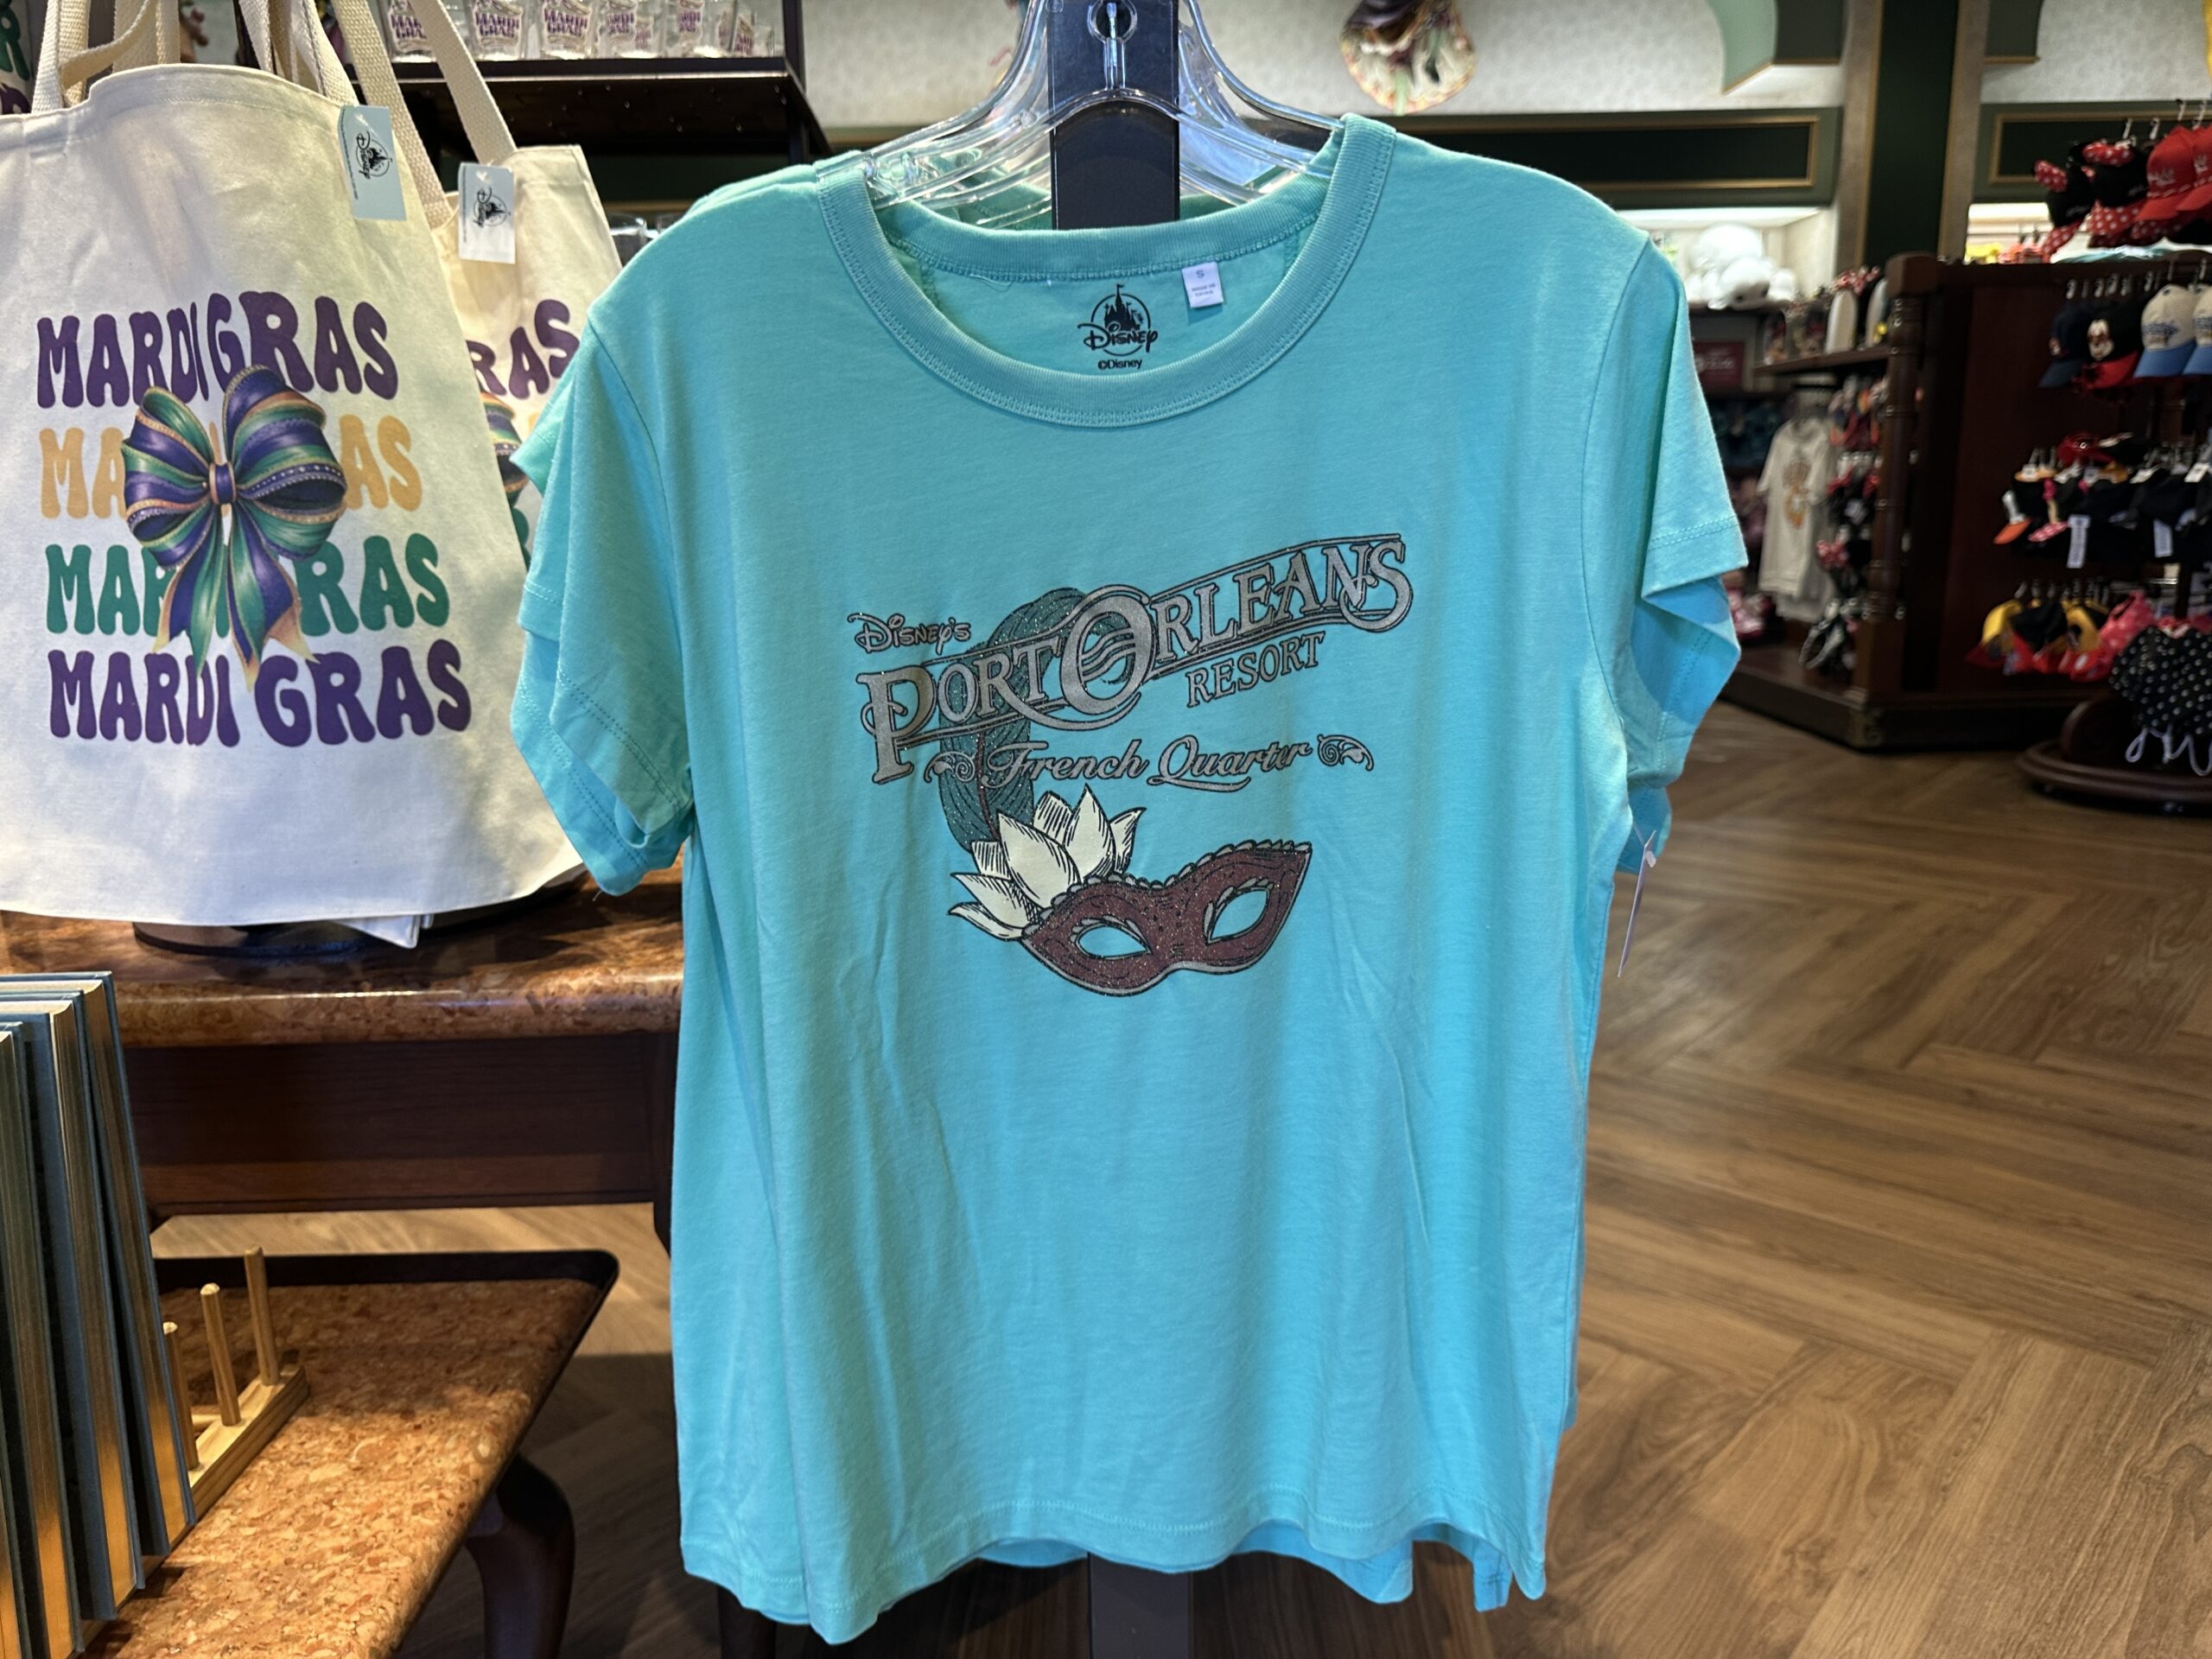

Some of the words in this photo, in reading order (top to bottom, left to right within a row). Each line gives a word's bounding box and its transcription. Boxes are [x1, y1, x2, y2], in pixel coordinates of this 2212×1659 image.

[37, 302, 209, 408] MARDI
[207, 290, 398, 401] GRAS
[465, 298, 581, 399] RAS
[1077, 322, 1159, 353] Disney
[338, 414, 423, 512] AS
[292, 532, 450, 637] RAS
[848, 613, 972, 656] Disney's
[855, 635, 1073, 785] PORT
[1060, 539, 1414, 715] ORLEANS
[1185, 631, 1326, 708] RESORT
[48, 650, 240, 747] MARDI
[254, 638, 472, 748] GRAS
[980, 738, 1150, 789] French
[1147, 734, 1313, 793] Quarter
